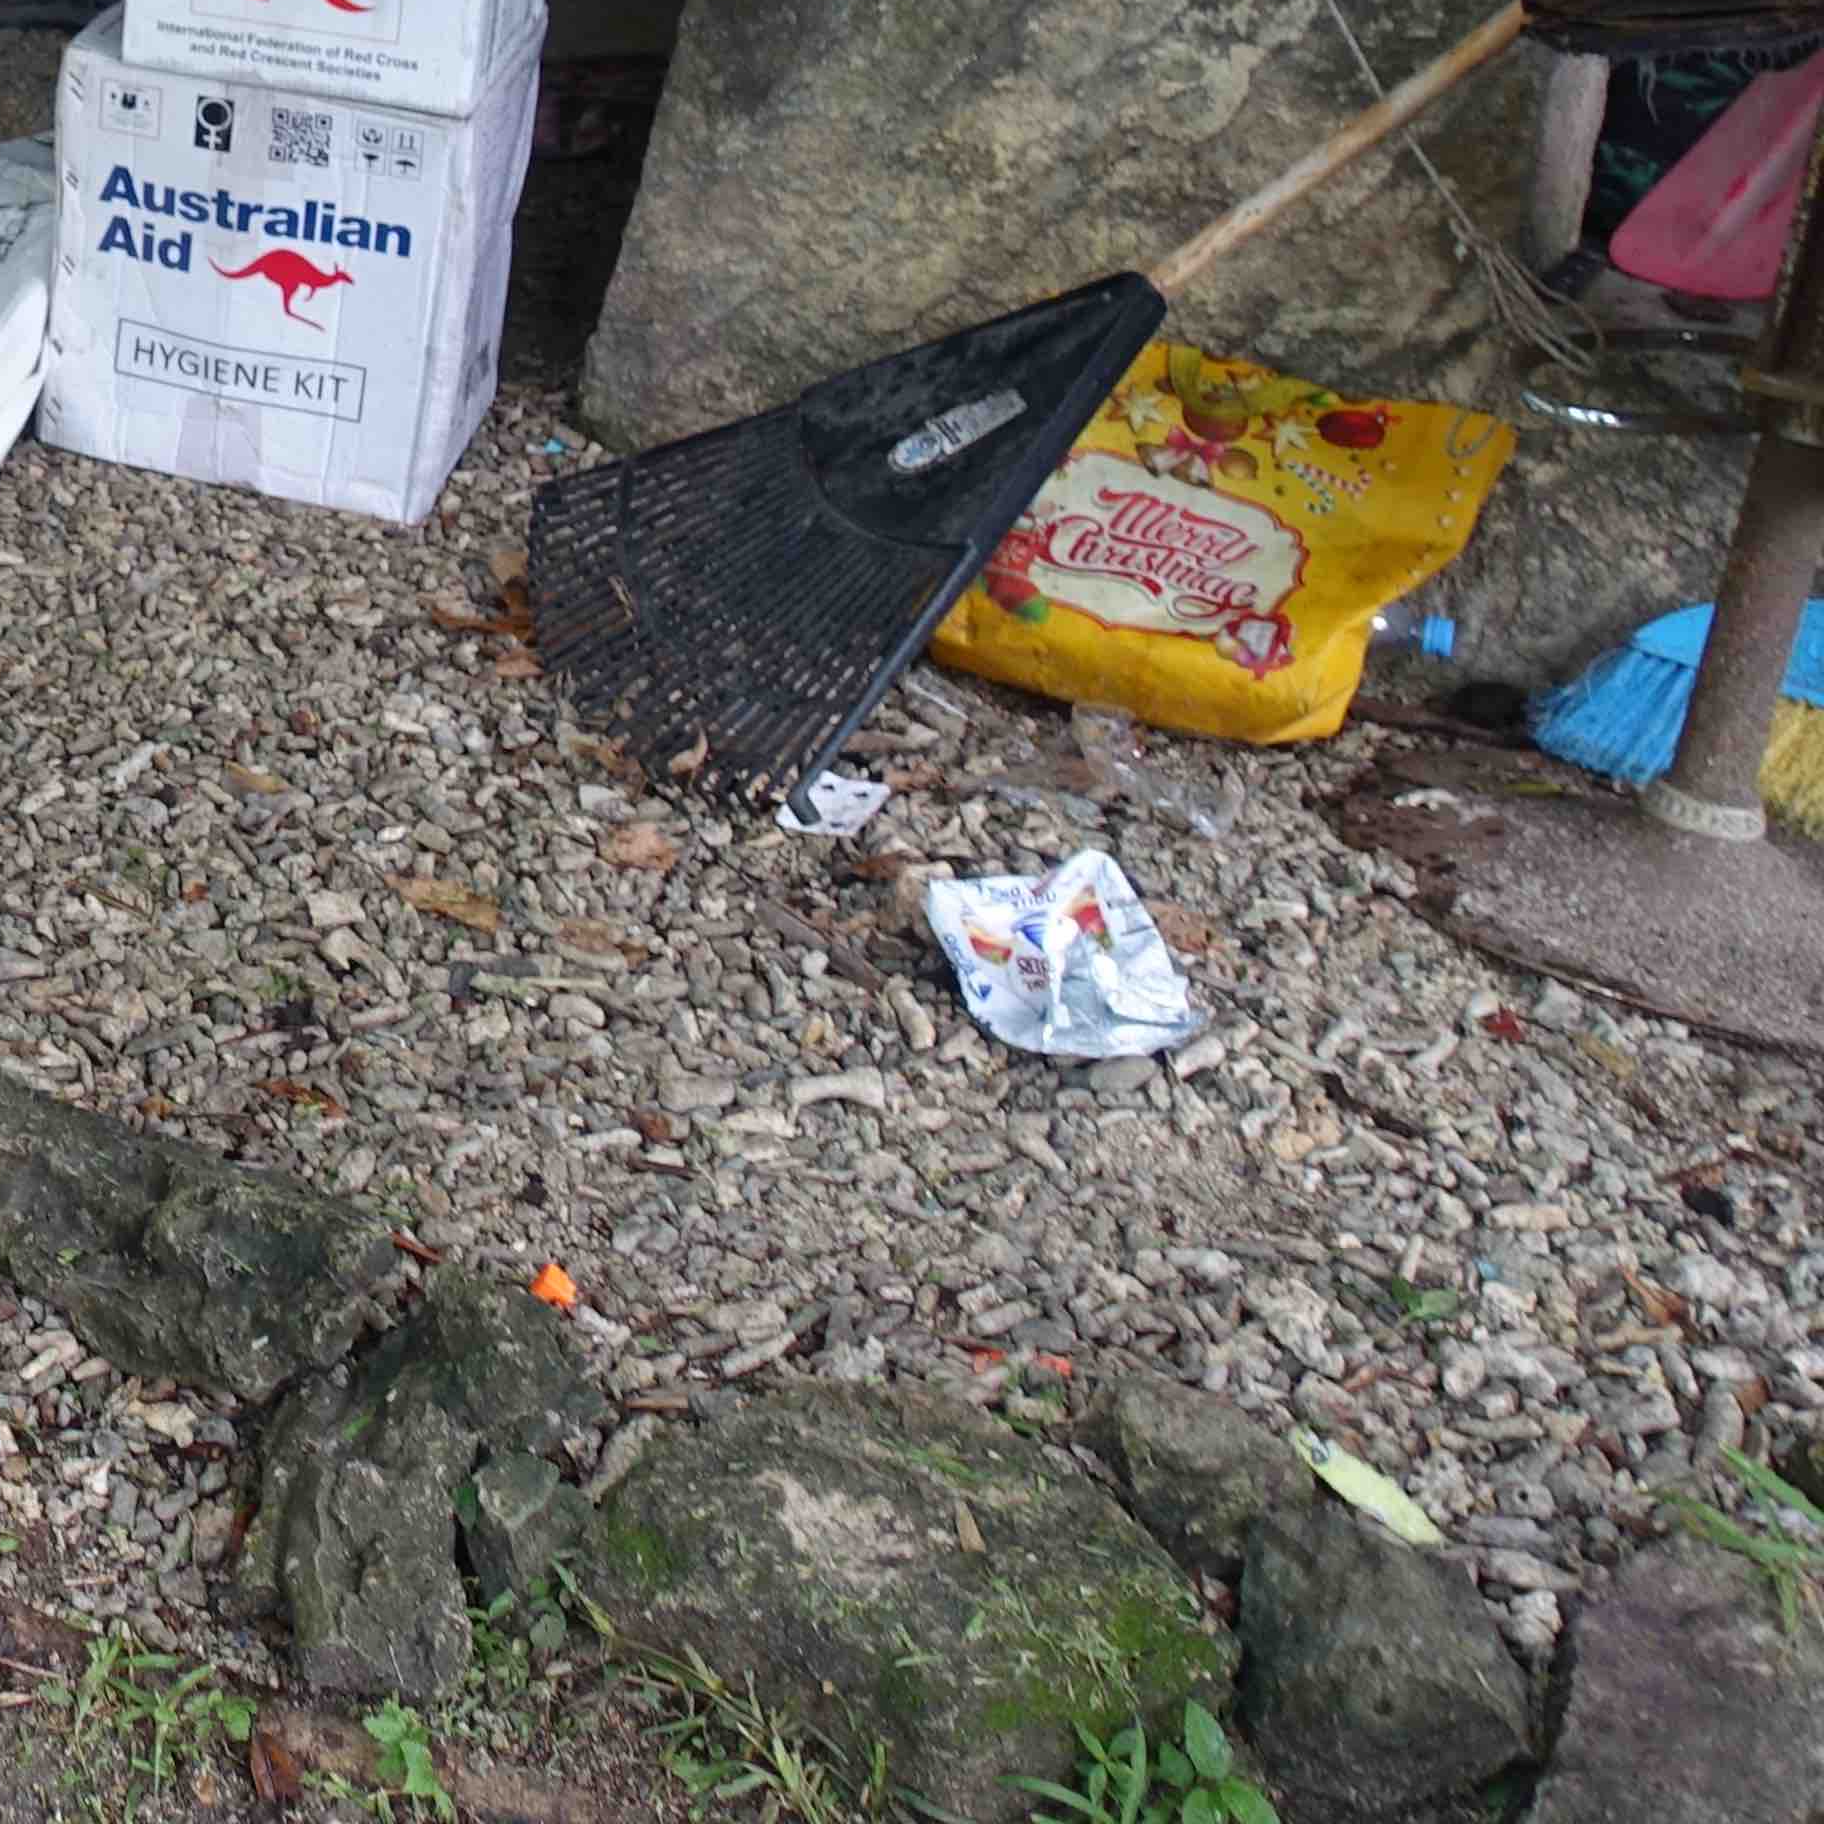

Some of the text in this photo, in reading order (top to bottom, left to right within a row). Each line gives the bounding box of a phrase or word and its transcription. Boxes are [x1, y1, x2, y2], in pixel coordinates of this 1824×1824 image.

[156, 20, 419, 71] International Federation of Red Cross
[189, 43, 382, 81] and Red Crescent Societies
[98, 164, 412, 258] Australian
[98, 215, 193, 273] Aid
[133, 335, 350, 404] HYGIENE KIT
[1092, 485, 1257, 567] Merry
